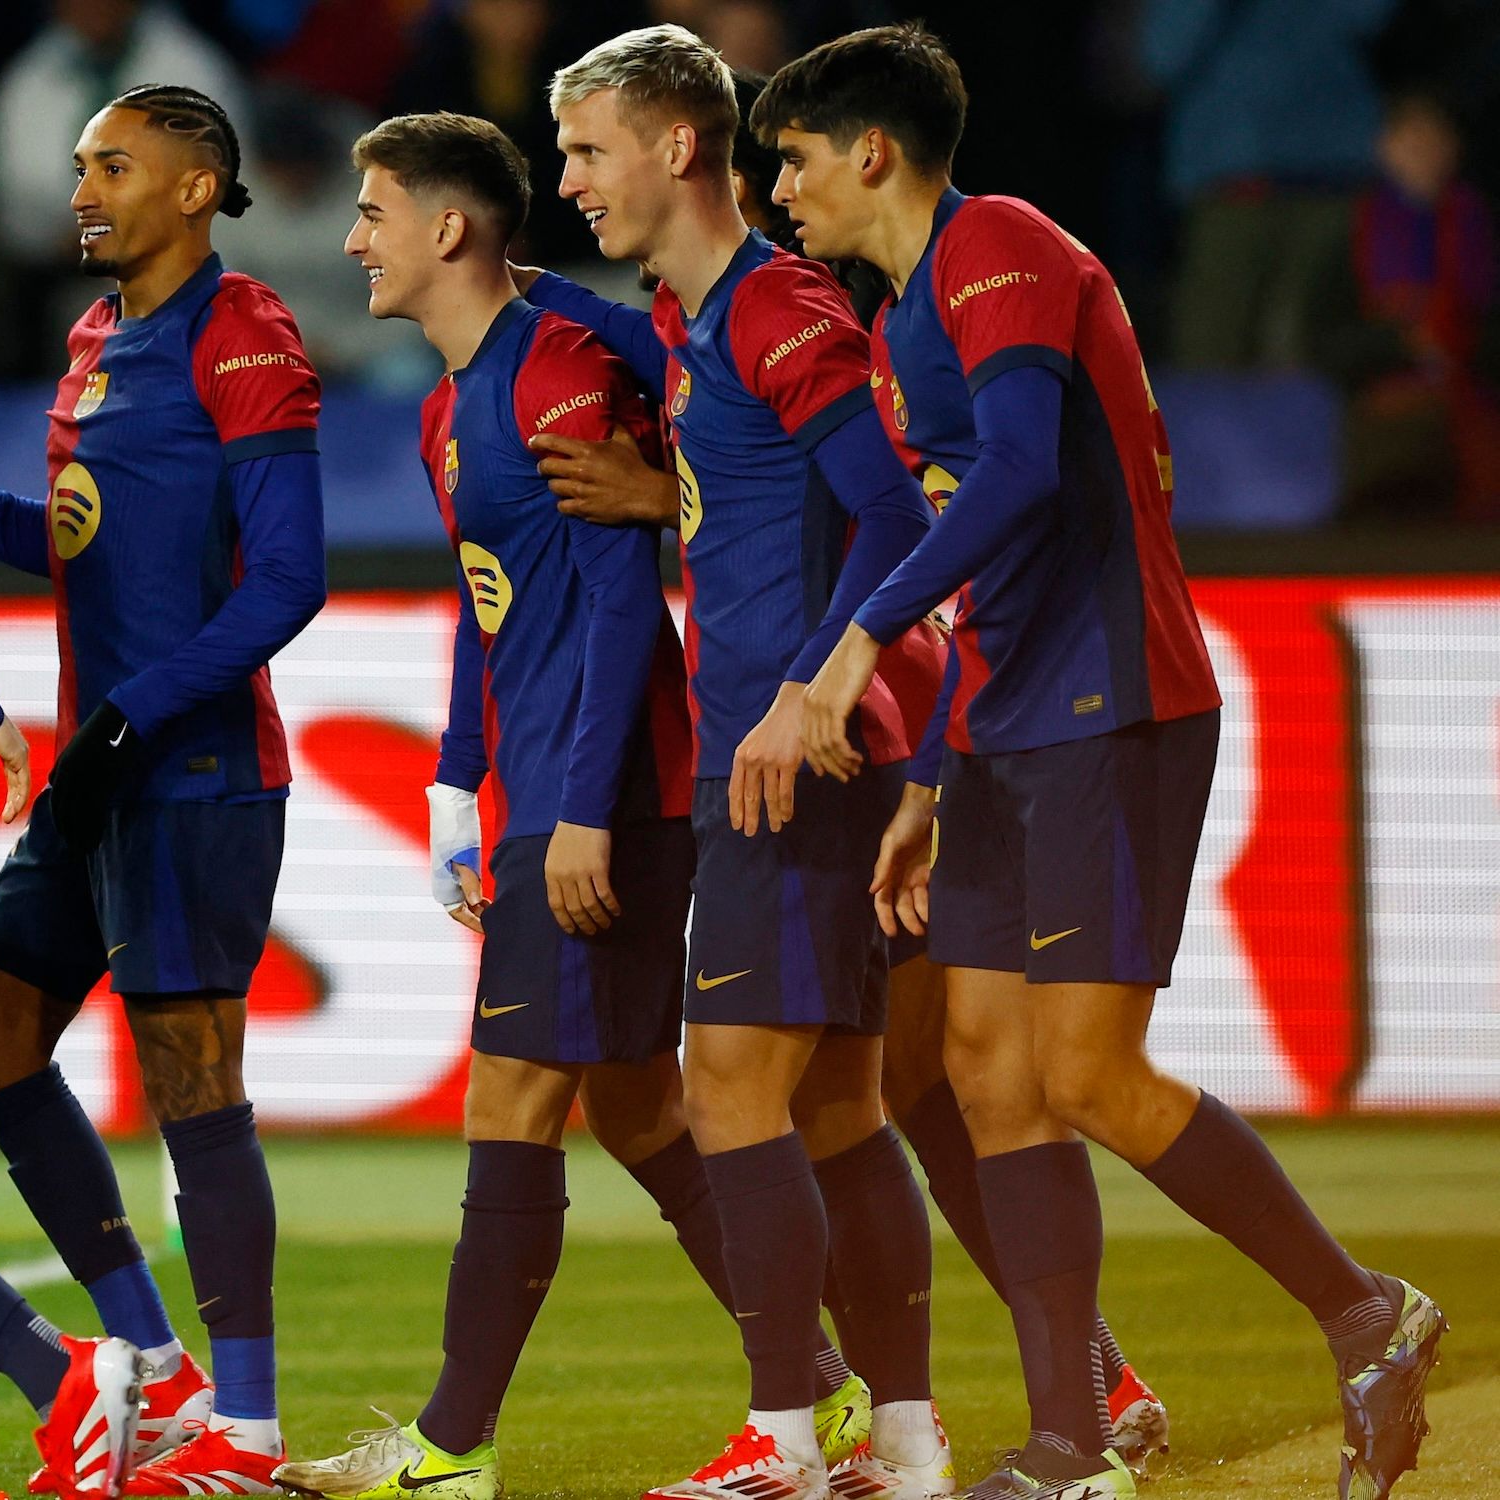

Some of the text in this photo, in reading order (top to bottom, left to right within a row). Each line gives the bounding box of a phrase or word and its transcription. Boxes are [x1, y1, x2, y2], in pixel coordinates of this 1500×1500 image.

[948, 271, 1038, 310] AMBILIGHT tv
[214, 353, 287, 375] AMBILIGHT
[764, 318, 833, 371] AMBILIGHT
[535, 391, 604, 432] AMBILIGHT
